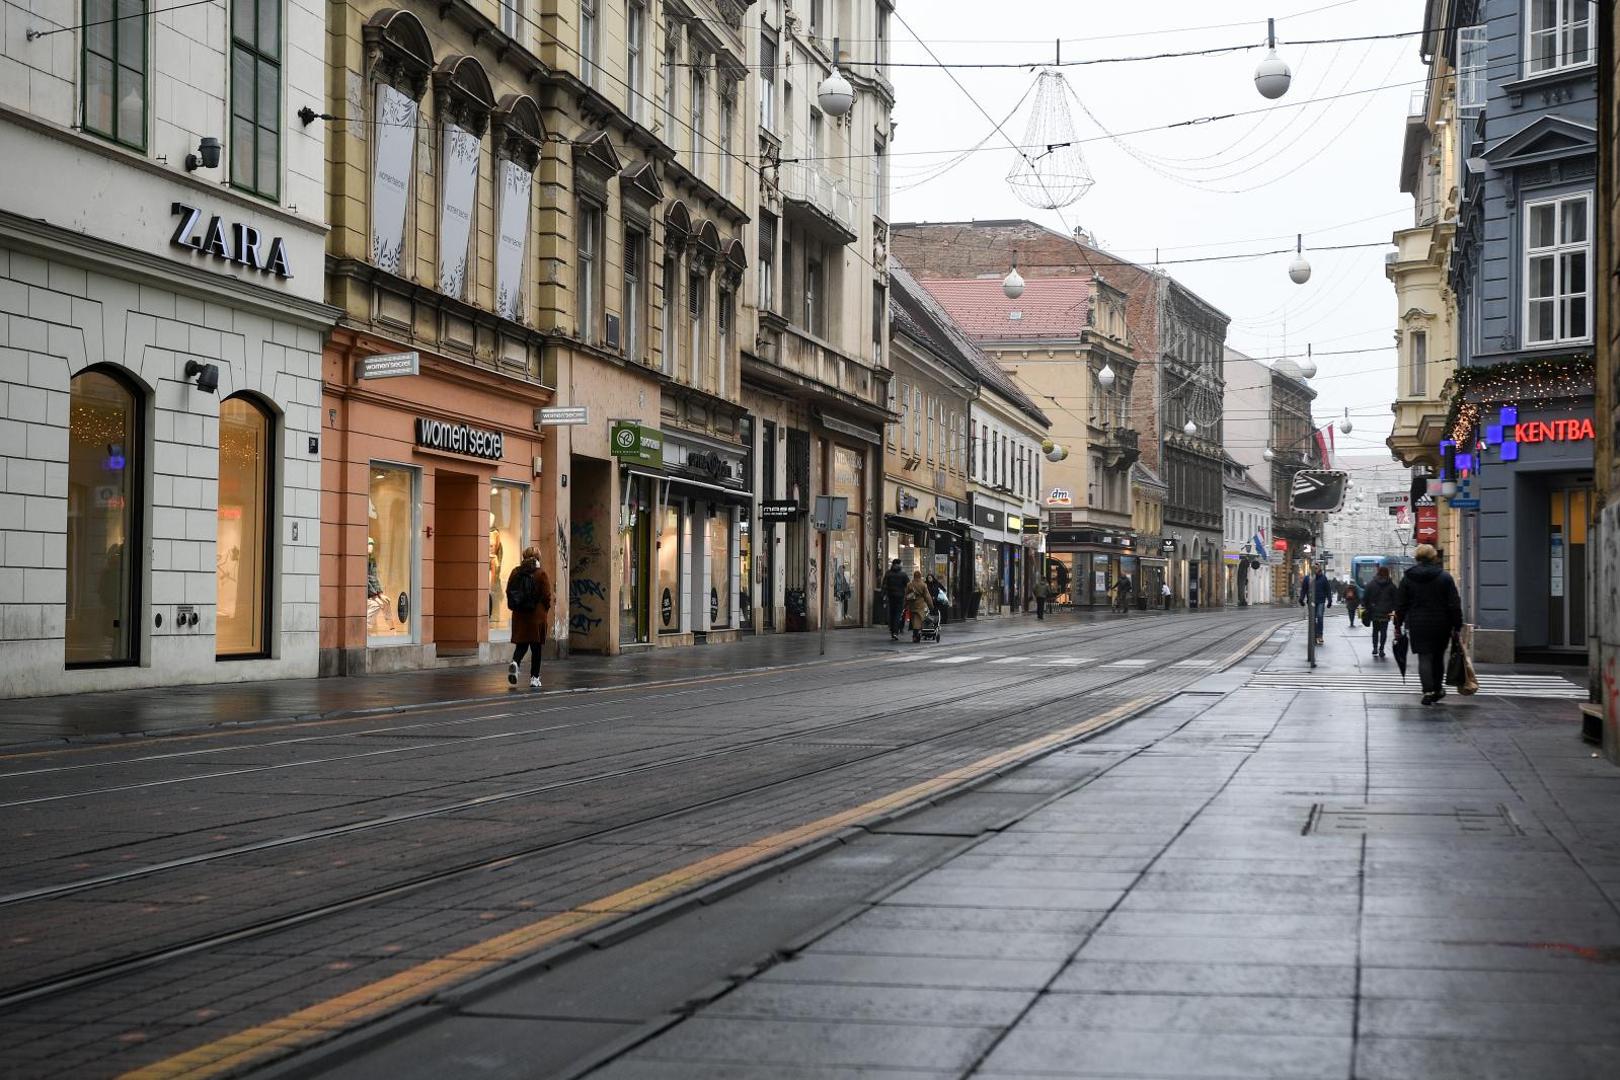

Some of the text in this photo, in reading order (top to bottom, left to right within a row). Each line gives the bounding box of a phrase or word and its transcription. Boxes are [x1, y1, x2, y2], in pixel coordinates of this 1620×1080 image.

[170, 202, 294, 280] ZARA
[365, 359, 411, 371] women'secret
[420, 417, 505, 459] women'secret
[1051, 487, 1068, 499] dm
